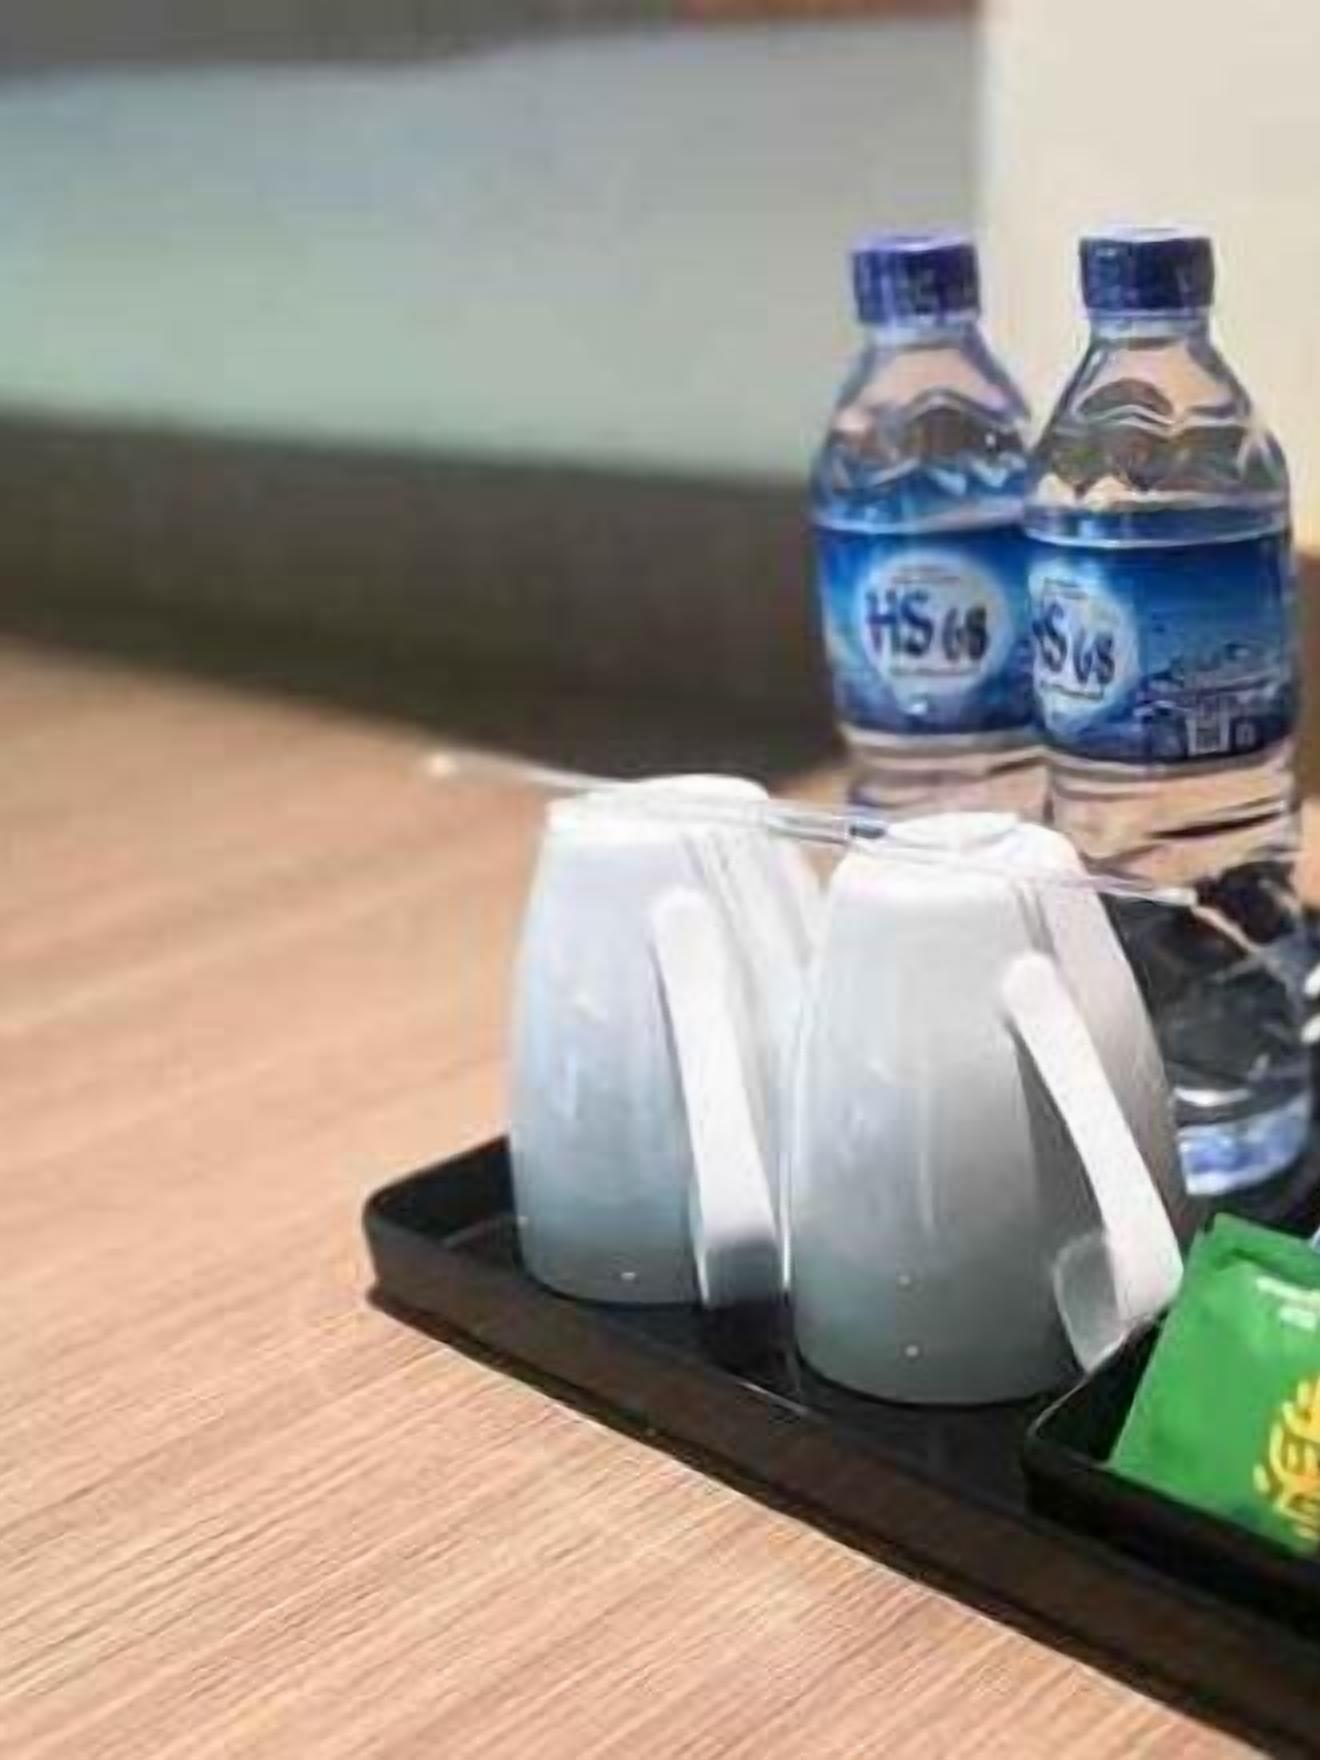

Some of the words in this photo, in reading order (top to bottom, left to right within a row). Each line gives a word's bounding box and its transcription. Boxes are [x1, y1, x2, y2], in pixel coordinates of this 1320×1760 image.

[865, 588, 935, 659] HS
[941, 604, 991, 664] 68
[1072, 628, 1115, 685] 68
